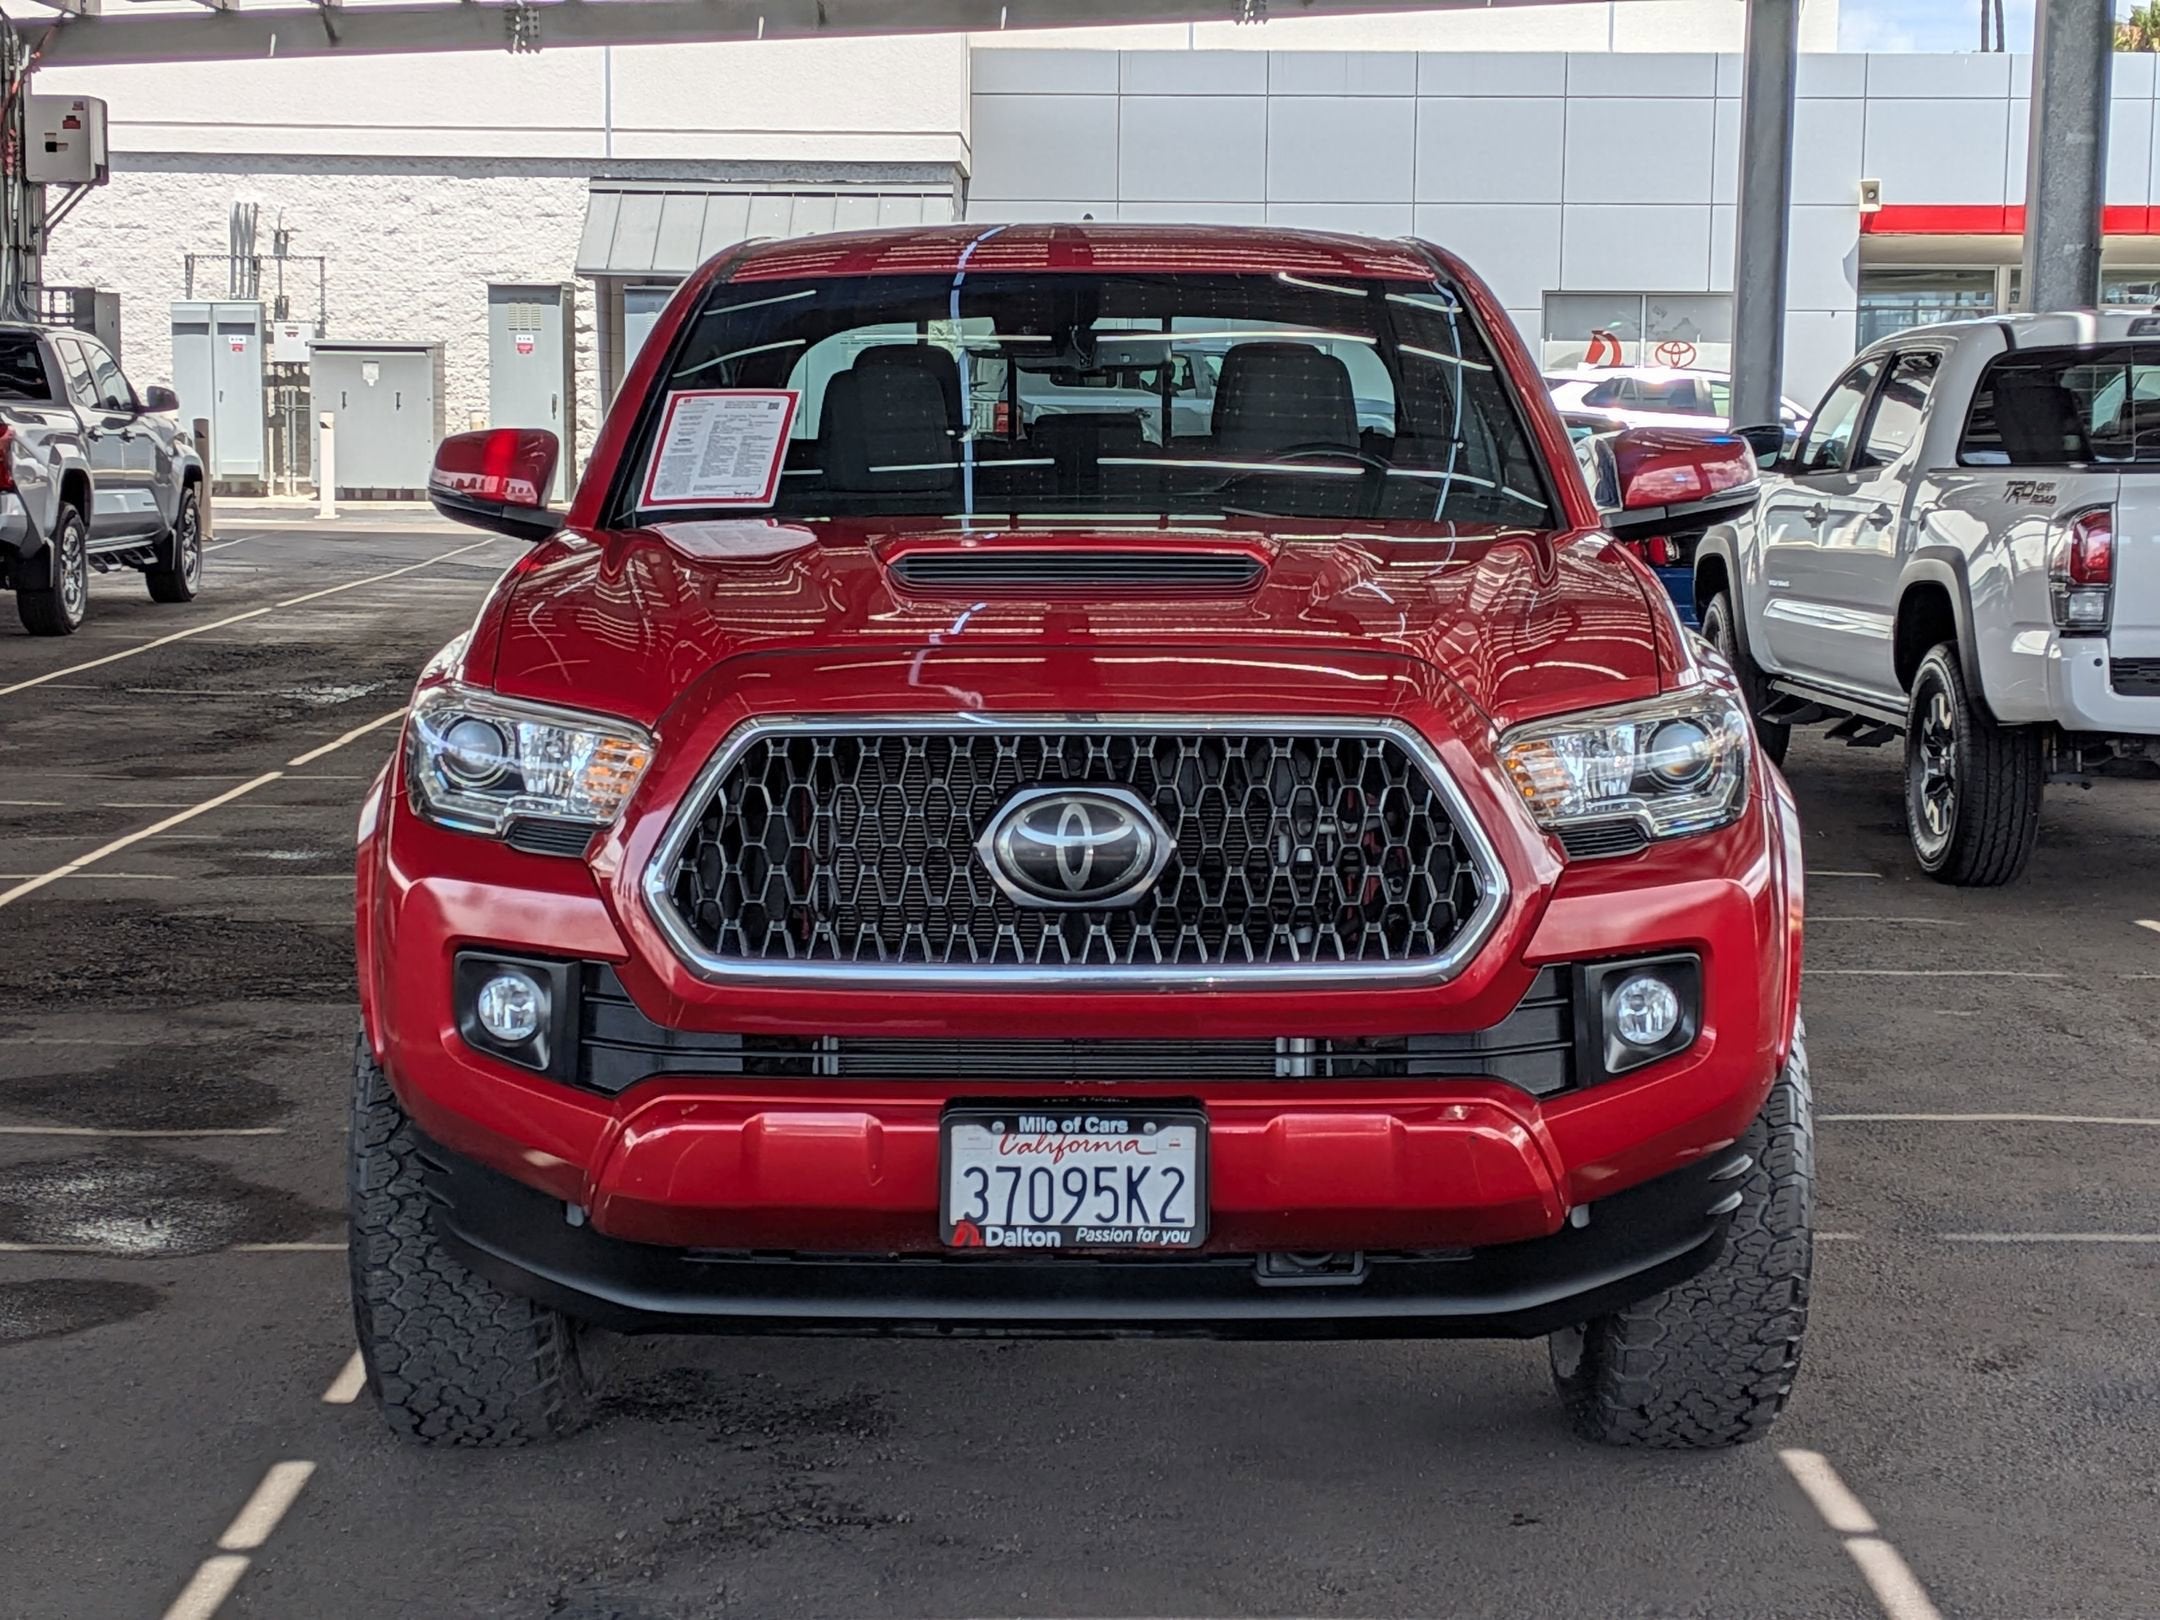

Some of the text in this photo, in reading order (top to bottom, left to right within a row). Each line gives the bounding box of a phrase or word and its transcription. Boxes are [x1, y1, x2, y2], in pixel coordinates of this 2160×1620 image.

[2003, 480, 2037, 504] TRD
[1018, 1116, 1129, 1134] Mile of Cars
[999, 1133, 1157, 1165] California
[963, 1165, 1186, 1225] 37095K2
[985, 1226, 1062, 1248] Dalton
[1075, 1227, 1191, 1245] Passion for you
